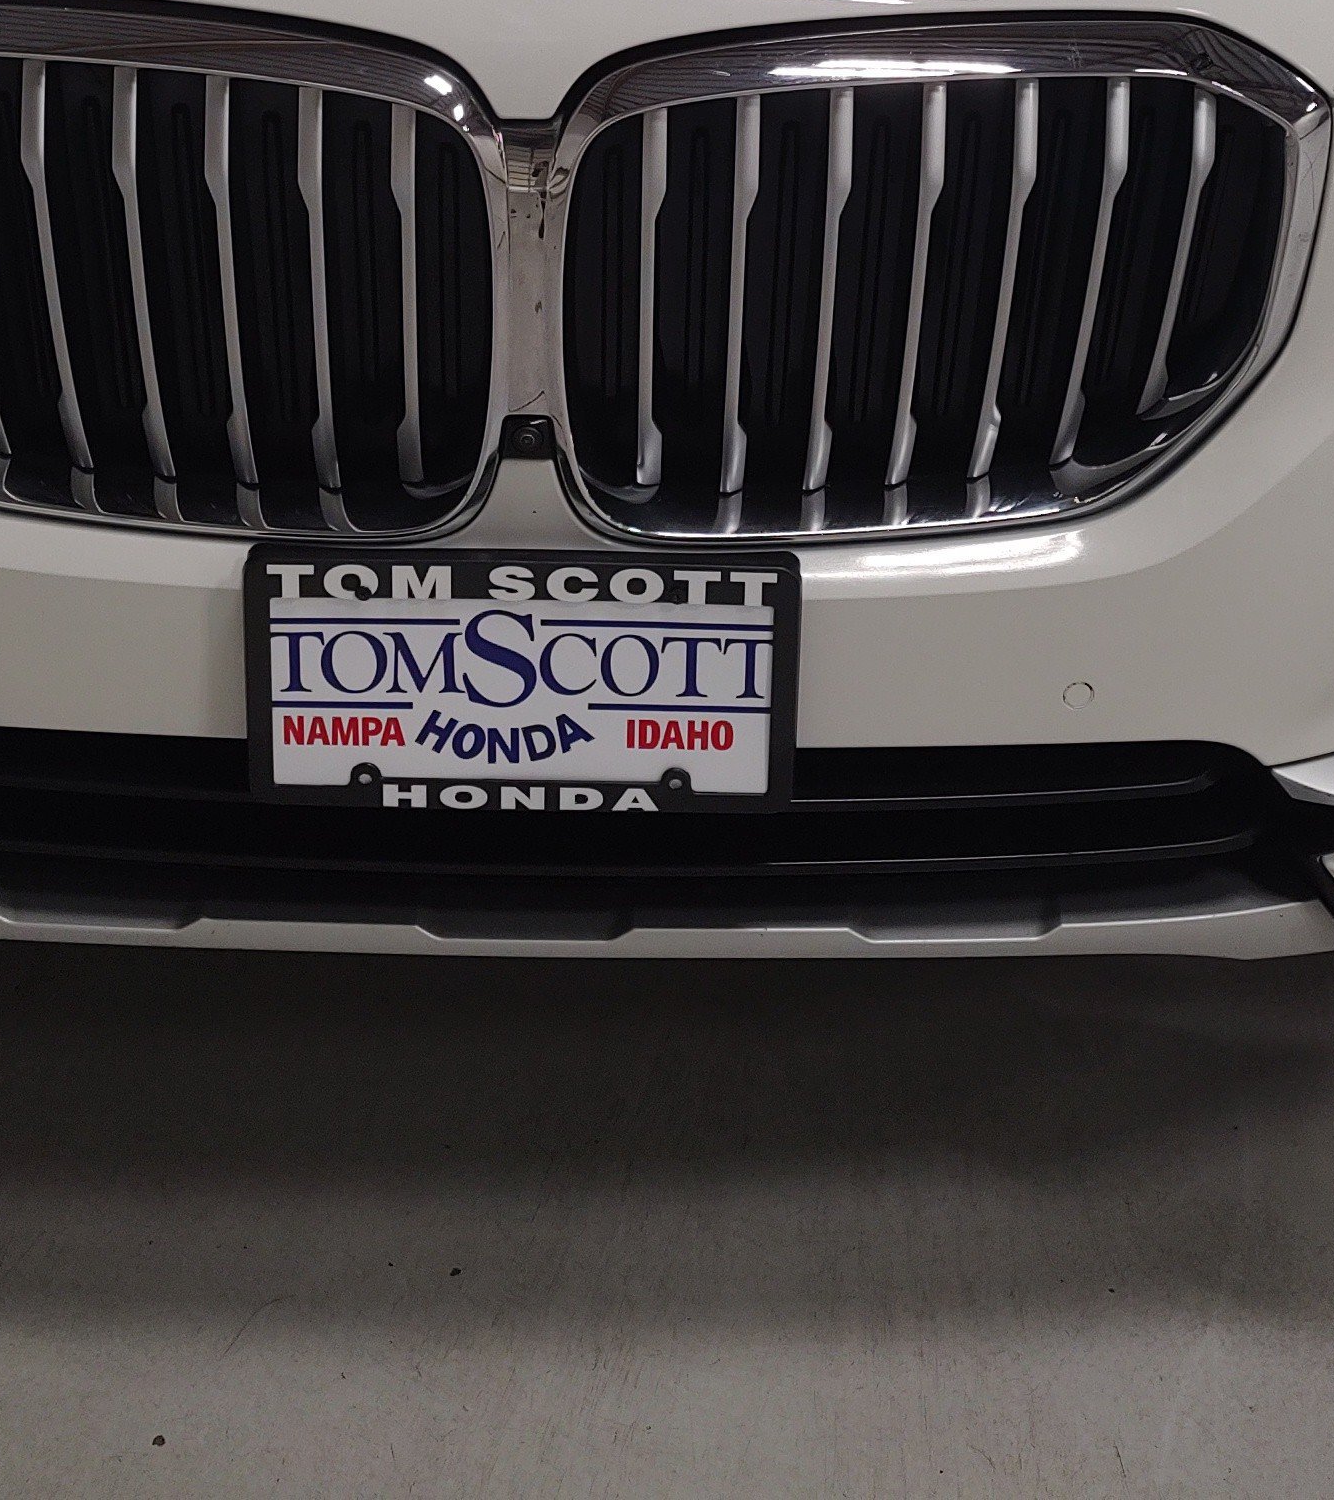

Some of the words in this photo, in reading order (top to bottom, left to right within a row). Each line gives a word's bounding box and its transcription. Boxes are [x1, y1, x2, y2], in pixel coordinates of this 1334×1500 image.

[266, 563, 452, 600] TOM
[488, 565, 778, 606] SCOTT
[283, 715, 406, 747] NAMPA
[414, 709, 595, 764] HONDA
[625, 719, 734, 751] IDAHO
[382, 783, 660, 812] HONDA
